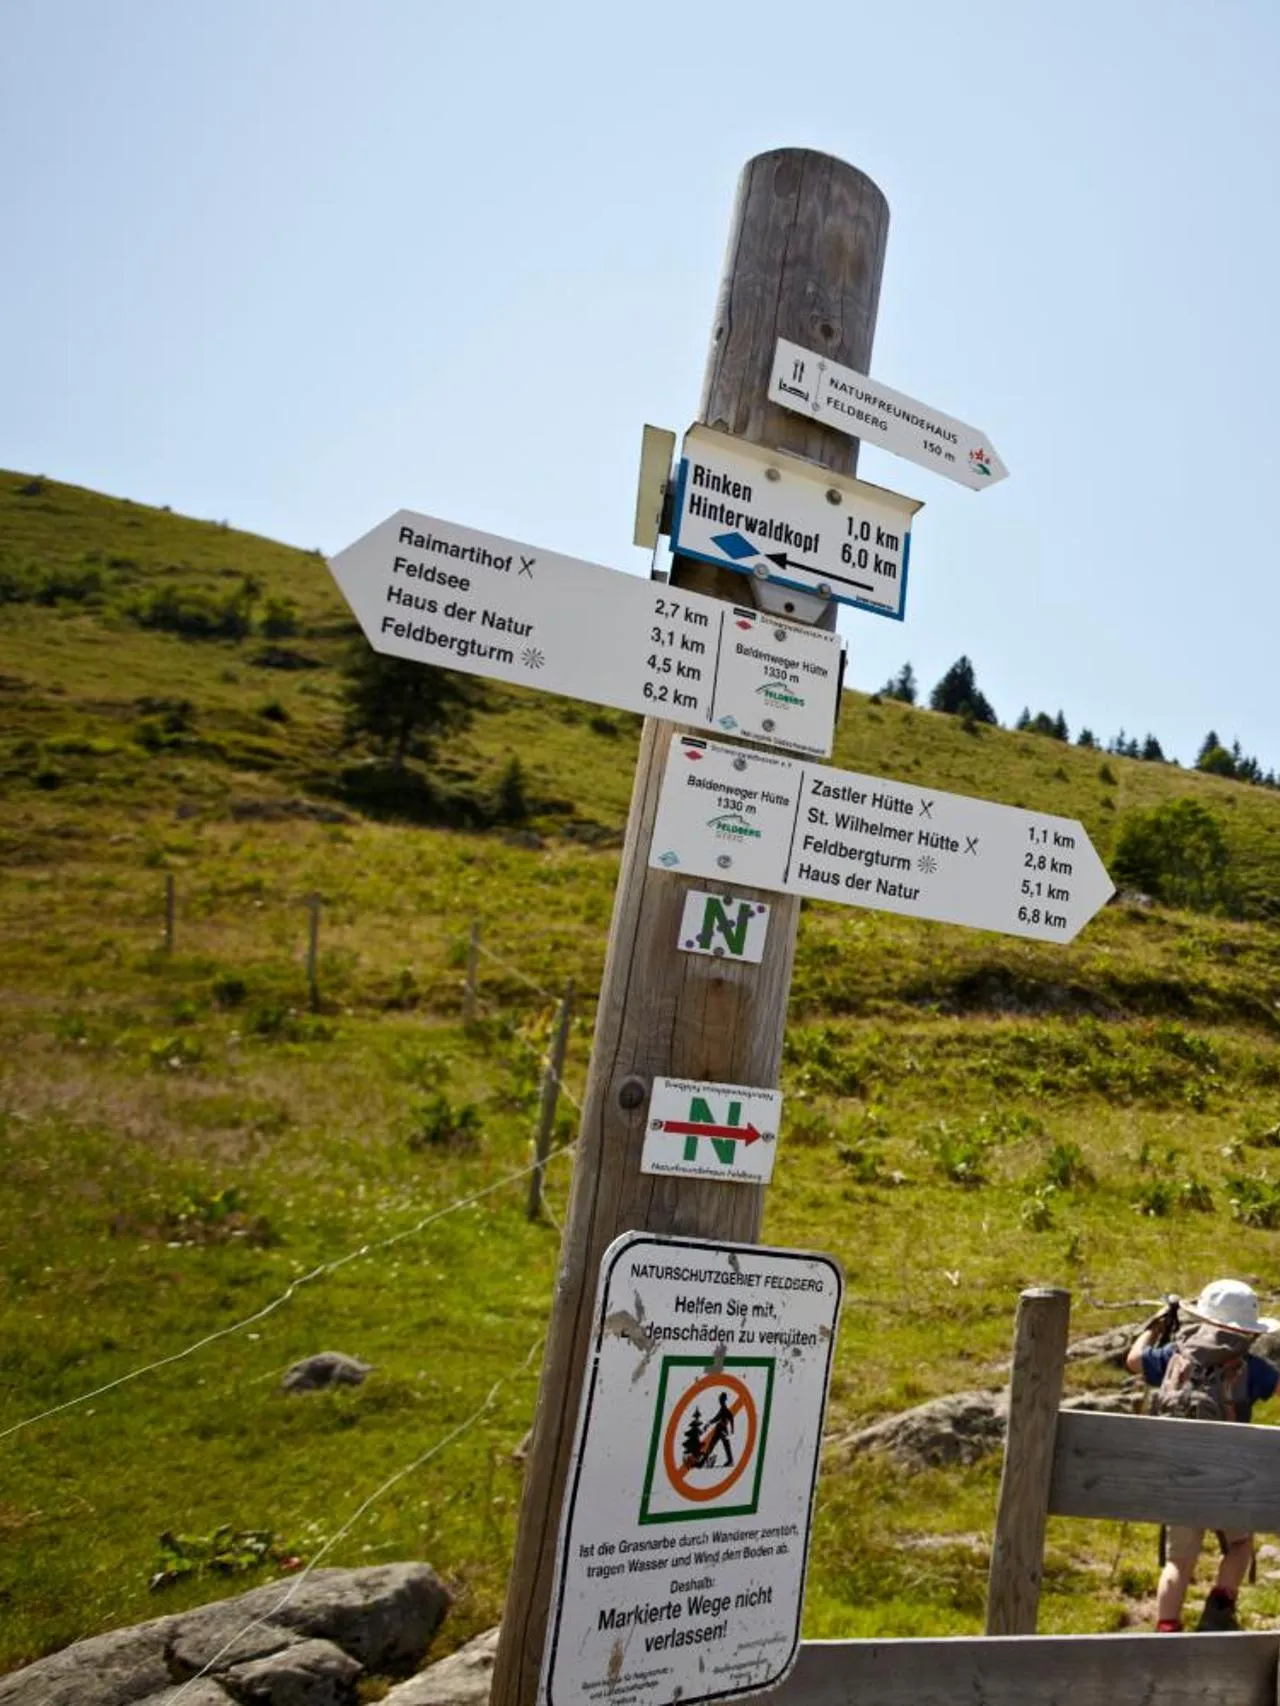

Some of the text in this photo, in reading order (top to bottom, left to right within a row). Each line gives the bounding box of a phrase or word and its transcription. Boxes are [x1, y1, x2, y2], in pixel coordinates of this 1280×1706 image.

[826, 397, 888, 431] FELDBERG
[829, 377, 958, 444] NATURFREUNDEHAUS
[922, 439, 956, 463] 150 m
[692, 464, 752, 502] Rinken
[689, 494, 820, 554] Hinterwaldkopf
[847, 516, 899, 551] 1,0 km
[398, 526, 513, 573] Raimartihof
[841, 543, 897, 579] 6,0 km
[393, 557, 470, 591] Feldsee
[386, 585, 533, 637] Haus der Natur
[655, 599, 680, 620] 2,7
[684, 607, 708, 627] km
[381, 616, 515, 664] Feldbergturm
[650, 627, 705, 654] 3,1 km
[647, 654, 701, 681] 4,5 km
[736, 642, 828, 678] Baldenweger Hütte
[764, 665, 800, 684] 1330 m
[643, 682, 698, 709] 6,2 km
[687, 774, 790, 807] Baldenweger Hütte
[717, 797, 756, 814] 1330 m
[811, 779, 914, 815] Zastler Hütte
[807, 808, 960, 853] St. Wilhelmer Hütte
[1028, 826, 1076, 849] 1,1 km
[802, 834, 912, 871] Feldbergturm
[1024, 853, 1072, 876] 2,8 km
[797, 863, 920, 901] Haus der Natur
[1021, 879, 1069, 902] 5,1 km
[1018, 906, 1067, 929] 6,8 km
[631, 1264, 824, 1292] NATURSCHUTZGEBIET FELDBERG
[674, 1296, 777, 1319] Helfen Sie mit,
[624, 1322, 735, 1343] denschäden
[739, 1331, 755, 1344] zu
[579, 1543, 595, 1558] Ist
[597, 1541, 616, 1556] die
[618, 1536, 676, 1554] Grasnarbe
[679, 1533, 709, 1547] durch
[587, 1563, 625, 1579] tragen
[628, 1558, 669, 1573] Wasser
[671, 1553, 692, 1568] und
[694, 1550, 720, 1565] Wind
[722, 1548, 742, 1561] den
[743, 1546, 774, 1559] Boden
[597, 1586, 773, 1632] Markierte Wege nicht
[644, 1620, 728, 1653] verlassen!
